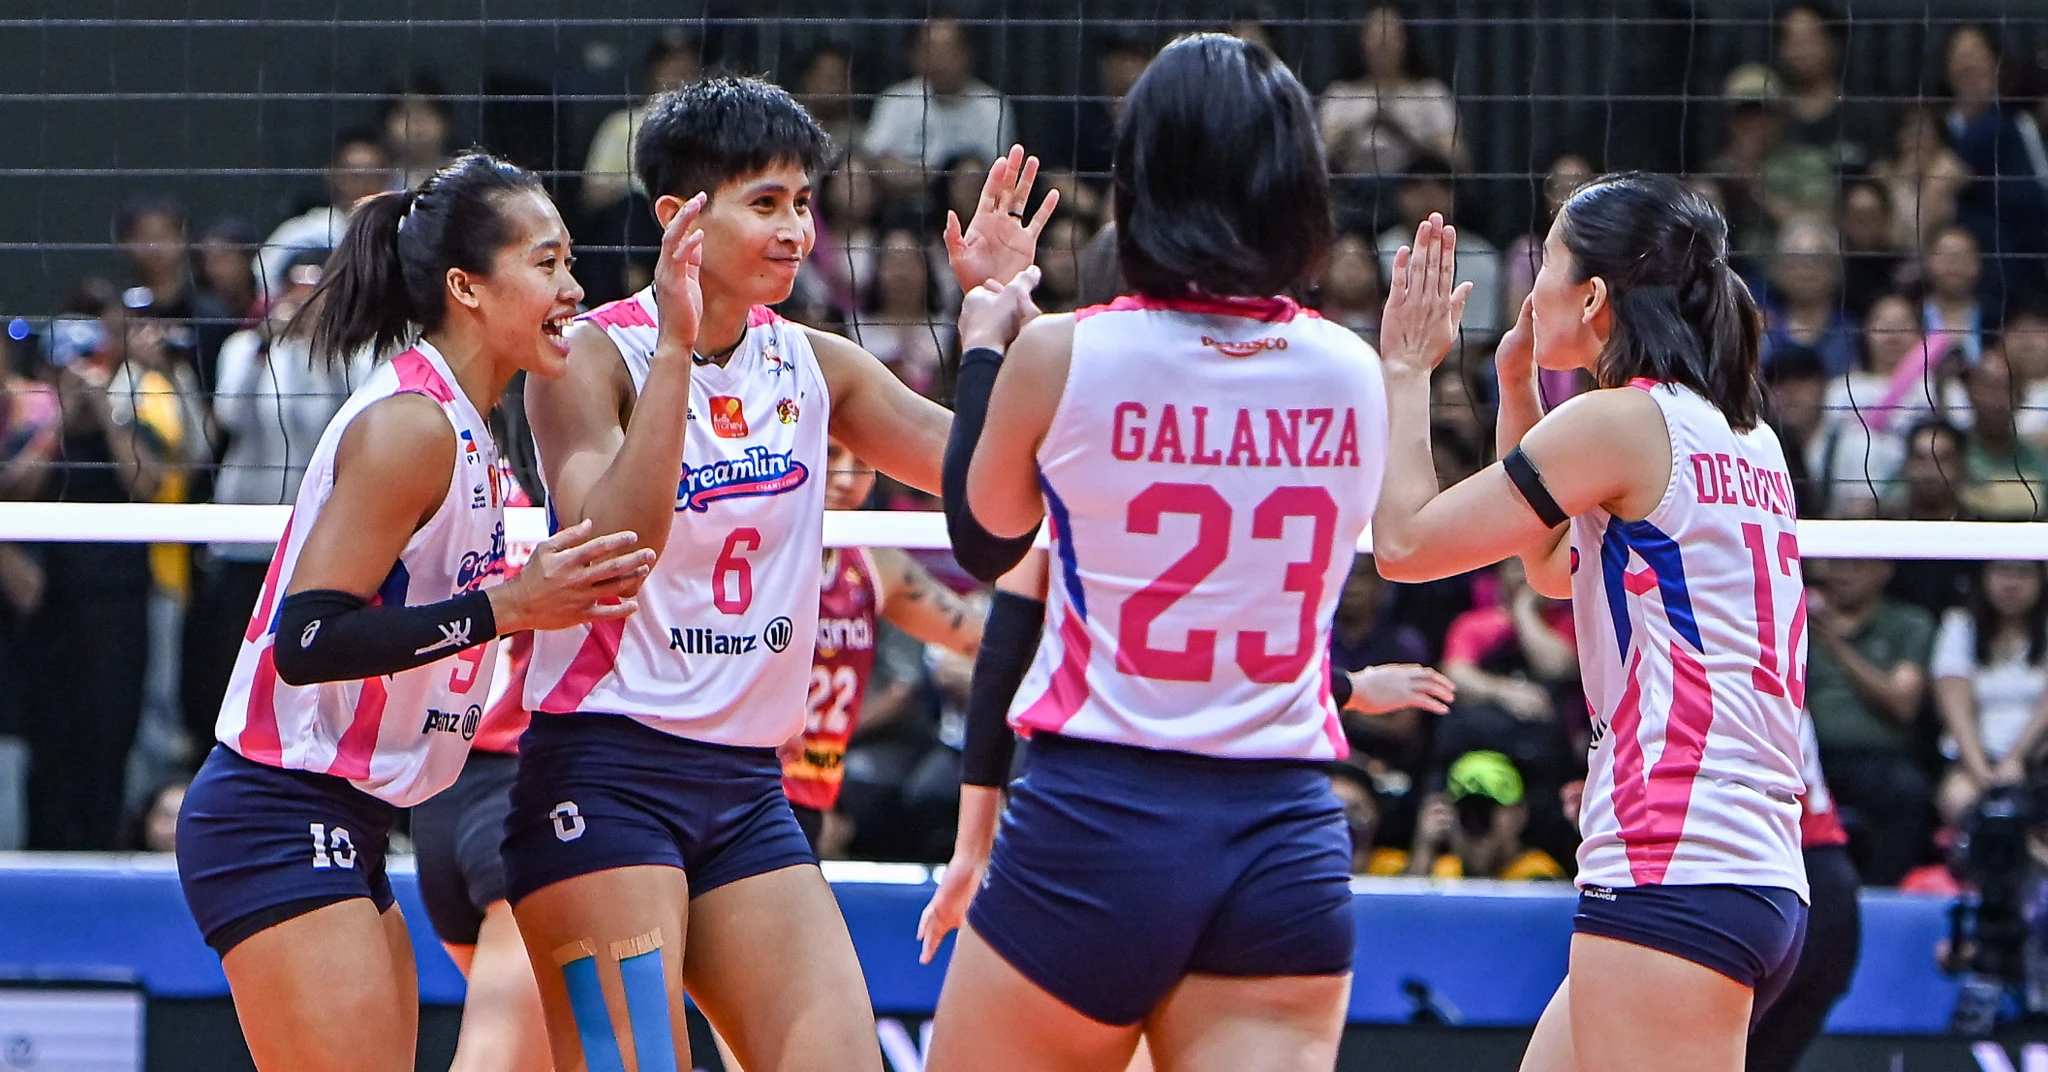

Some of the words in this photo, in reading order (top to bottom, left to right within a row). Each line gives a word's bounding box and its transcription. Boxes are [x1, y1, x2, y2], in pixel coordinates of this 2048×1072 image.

[1111, 401, 1361, 468] GALANZA
[1690, 453, 1738, 505] DE
[712, 527, 761, 616] 6
[1115, 481, 1339, 684] 23
[670, 627, 758, 655] Allianz
[1740, 521, 1808, 711] 12
[805, 664, 858, 734] 22
